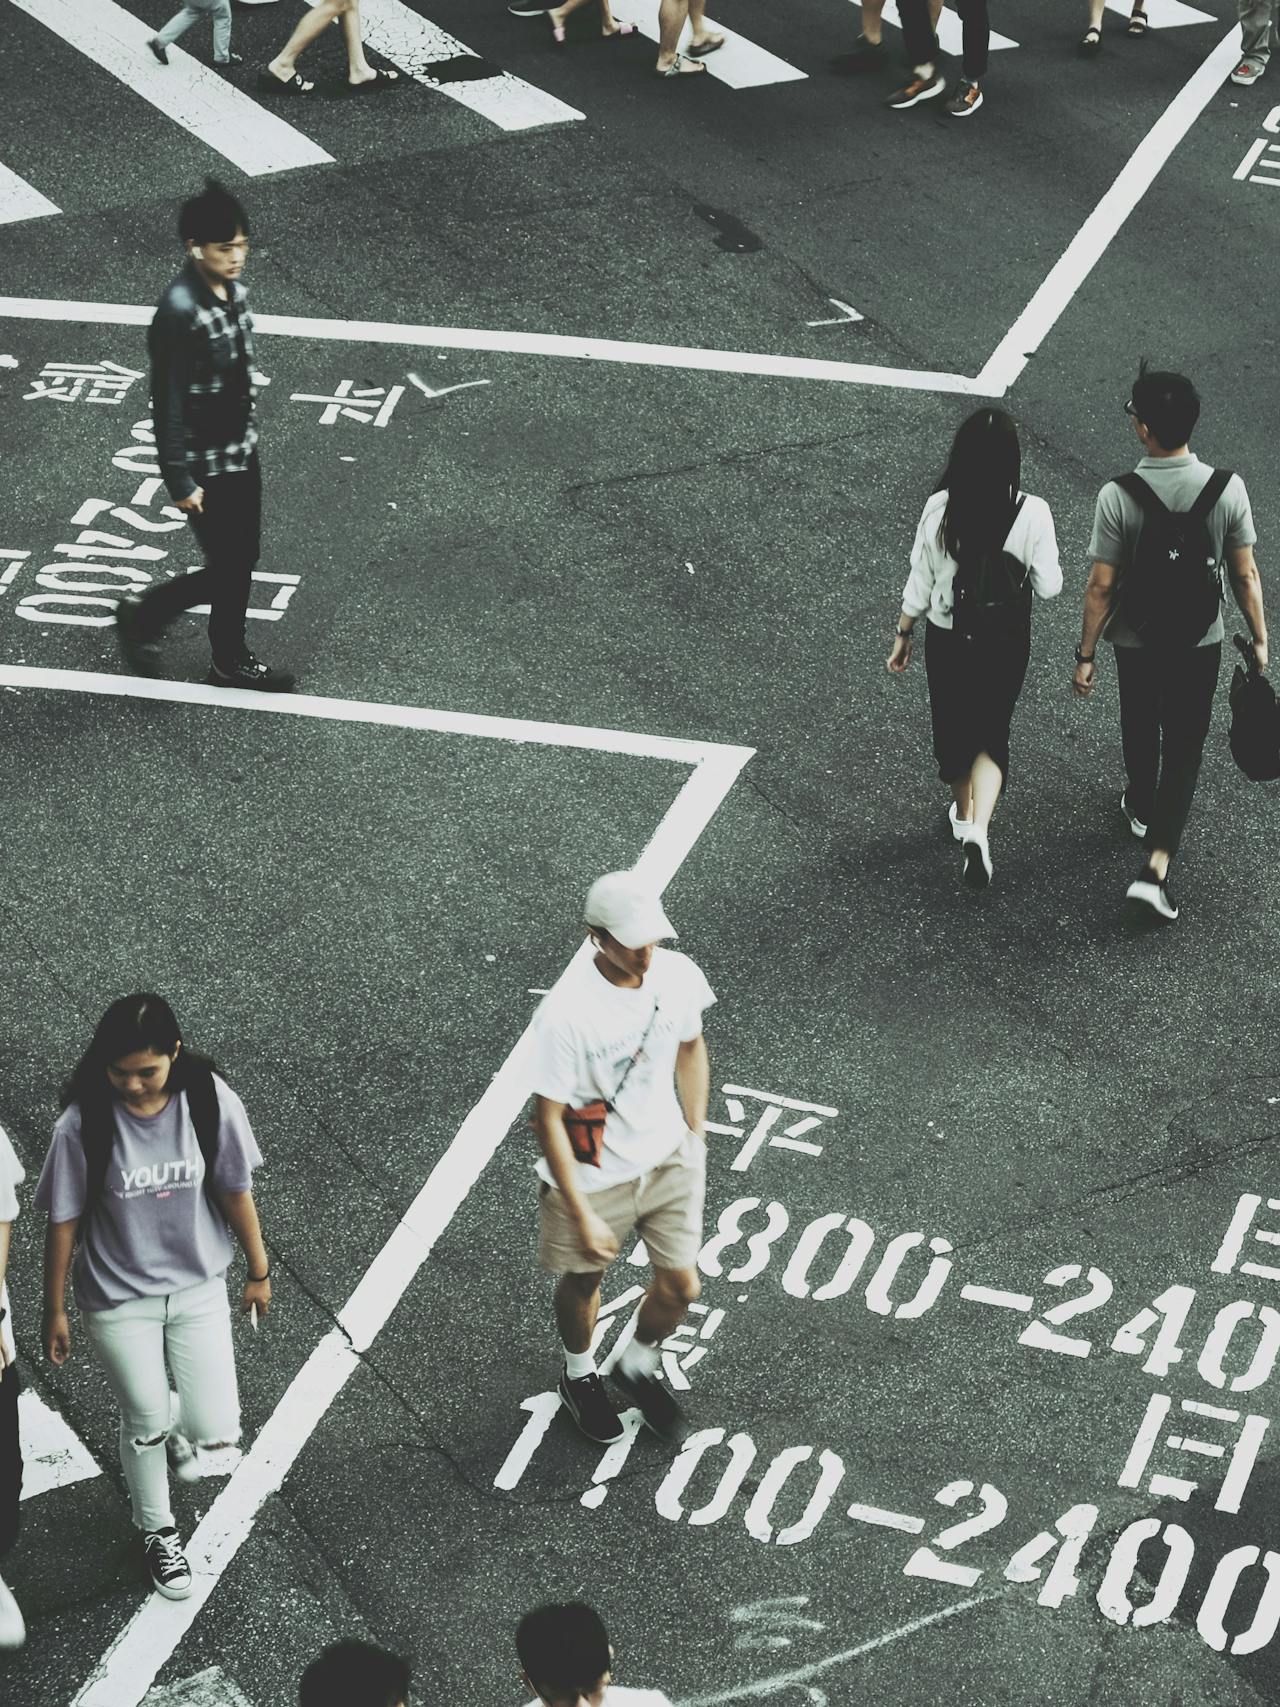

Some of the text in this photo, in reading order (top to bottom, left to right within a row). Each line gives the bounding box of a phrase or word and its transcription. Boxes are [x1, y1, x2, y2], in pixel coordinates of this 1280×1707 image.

[289, 379, 405, 427] 平
[703, 1083, 838, 1171] 平
[121, 1156, 200, 1191] YOUTH
[1118, 1394, 1270, 1514] 日
